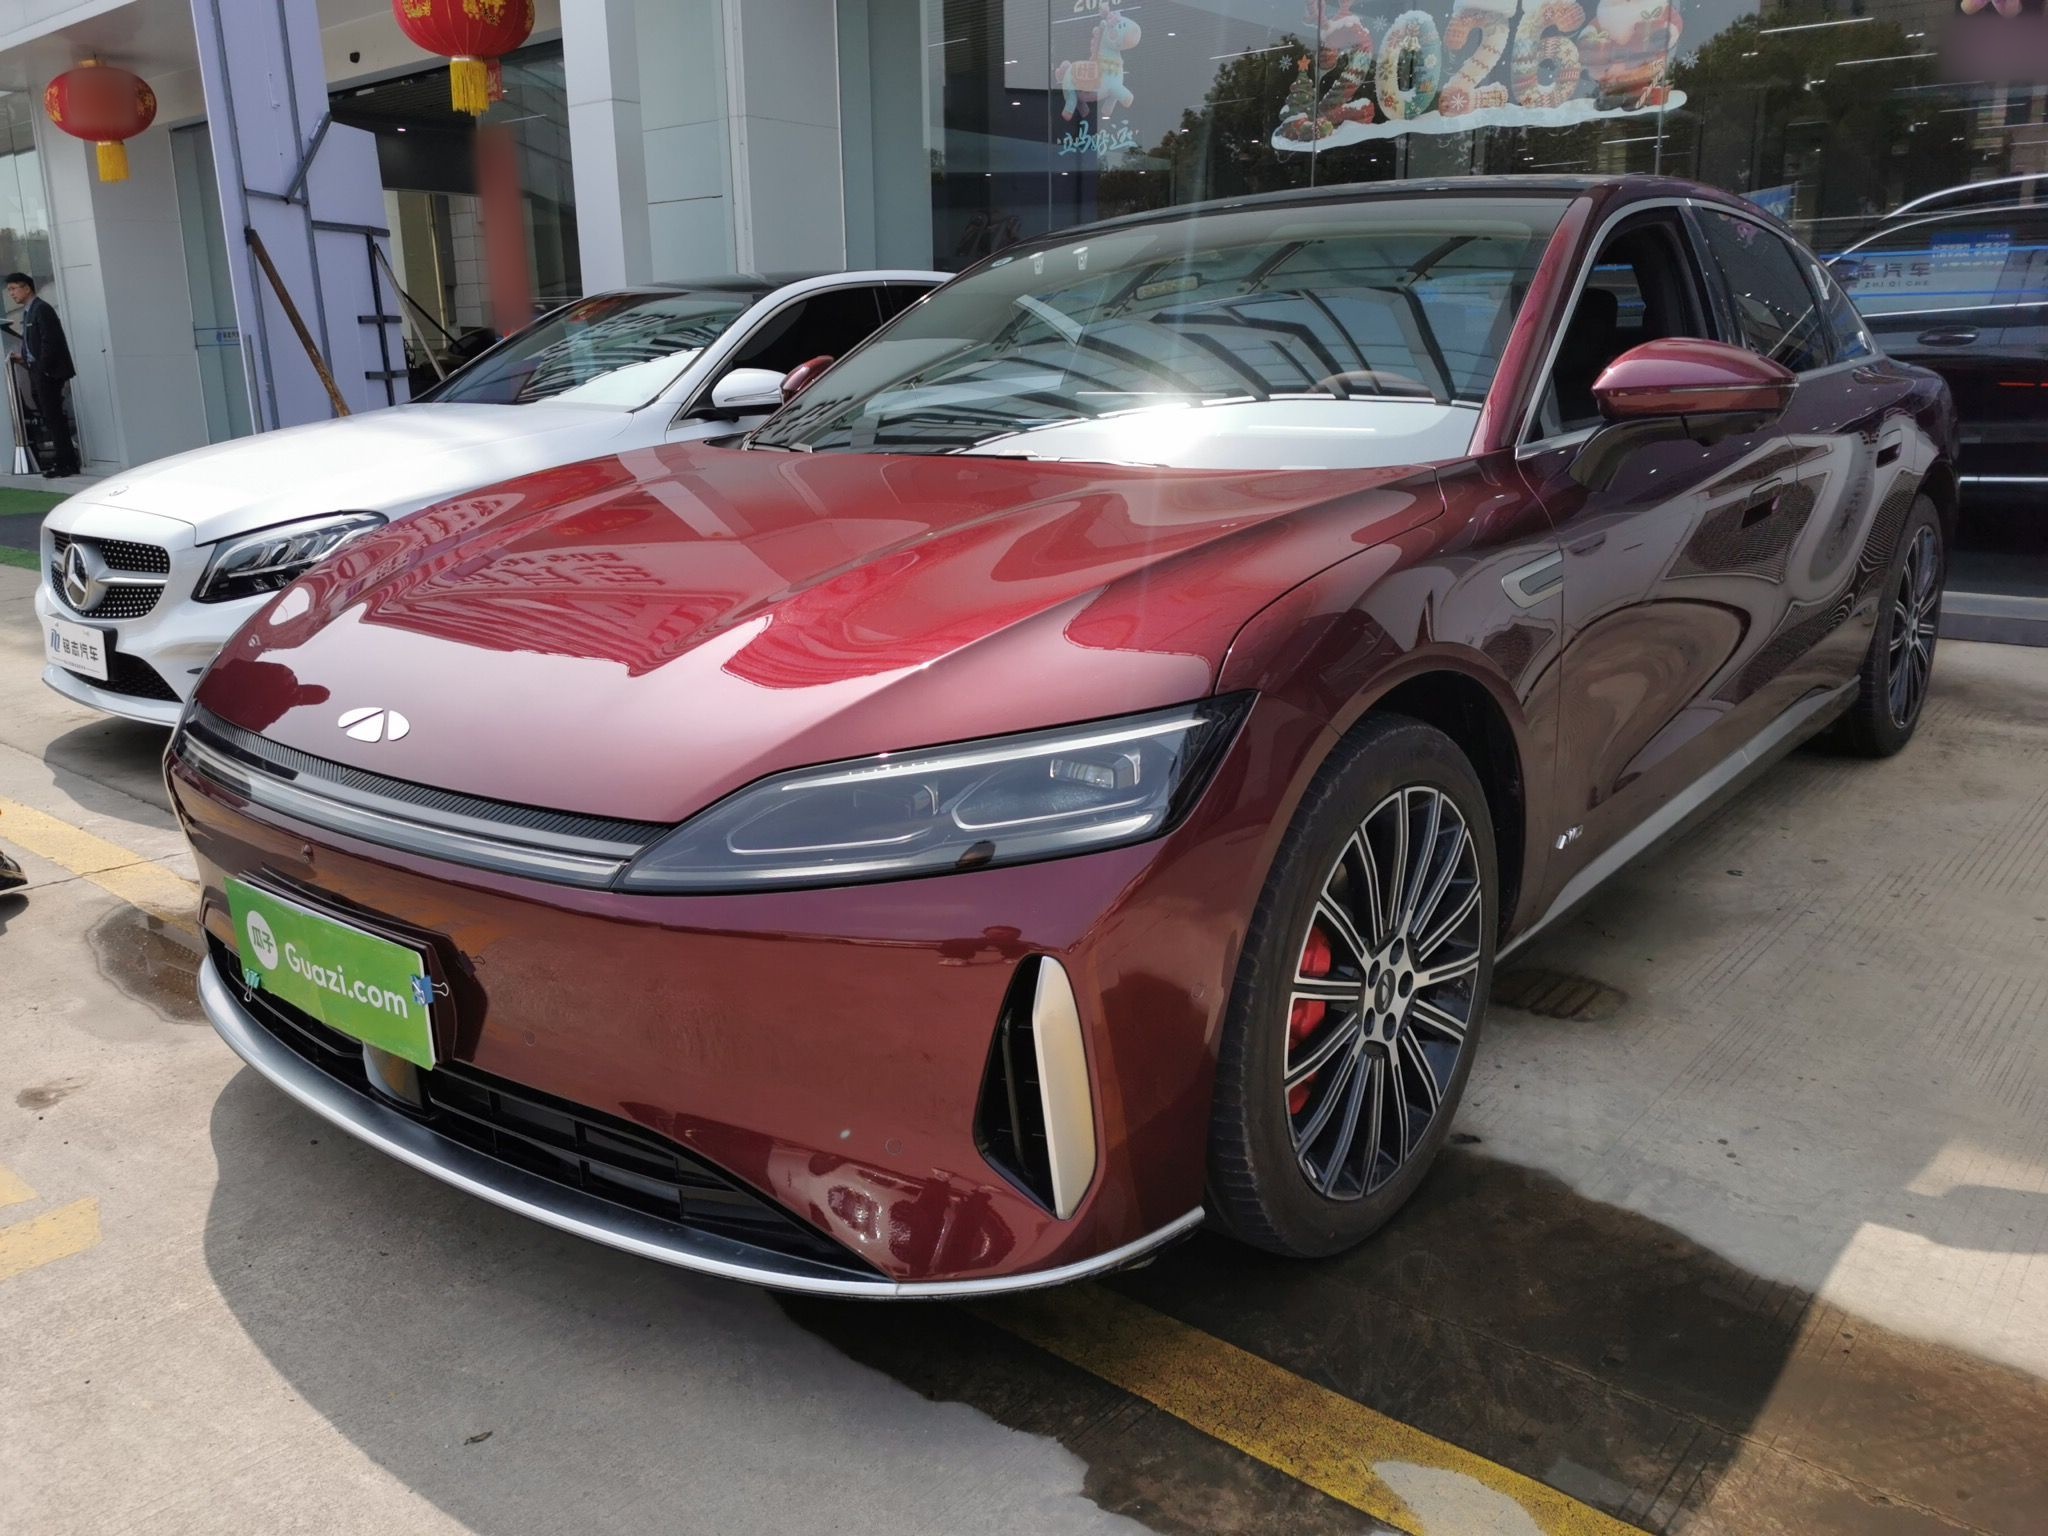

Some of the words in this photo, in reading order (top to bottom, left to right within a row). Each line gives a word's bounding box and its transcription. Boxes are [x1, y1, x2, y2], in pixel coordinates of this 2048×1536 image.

[1316, 0, 1585, 128] 2026
[251, 925, 275, 953] 瓜子
[284, 941, 409, 1019] Guazi.com
